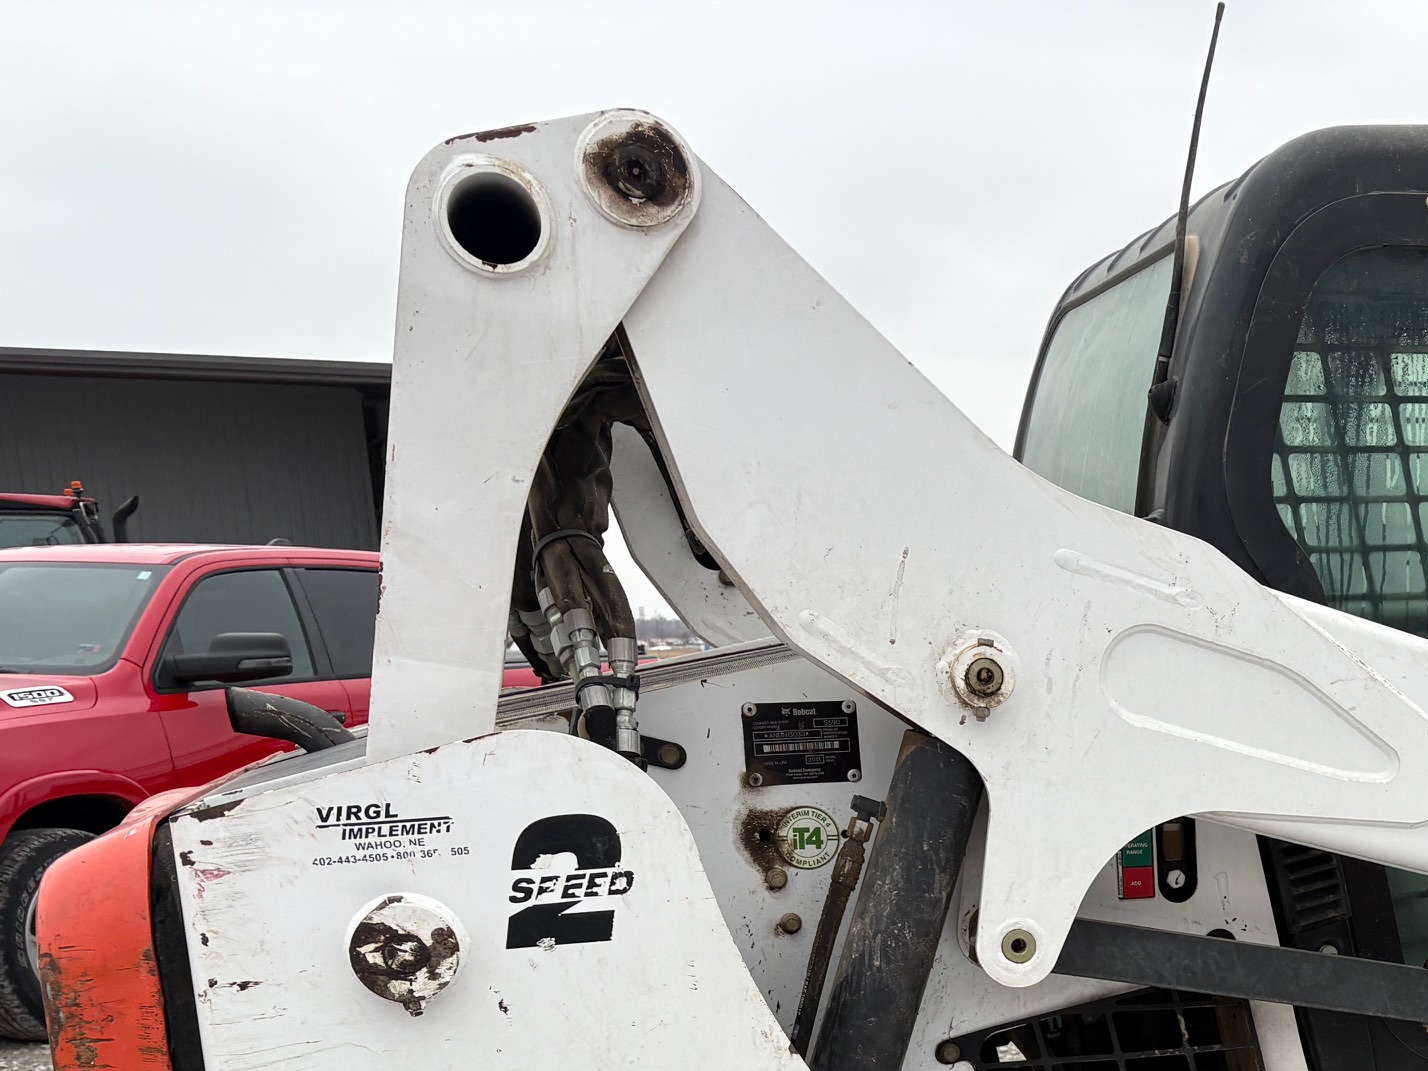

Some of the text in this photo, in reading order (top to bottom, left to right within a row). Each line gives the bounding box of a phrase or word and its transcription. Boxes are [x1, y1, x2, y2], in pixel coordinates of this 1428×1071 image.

[9, 689, 63, 701] 1500
[315, 803, 399, 823] VIRGL
[782, 810, 810, 828] INTERIM
[810, 810, 828, 823] TIER
[341, 821, 454, 841] IMPLEMENT
[409, 838, 426, 847] NE
[785, 851, 831, 867] COMPLIANT
[506, 813, 622, 950] 2
[508, 870, 635, 904] SPEED
